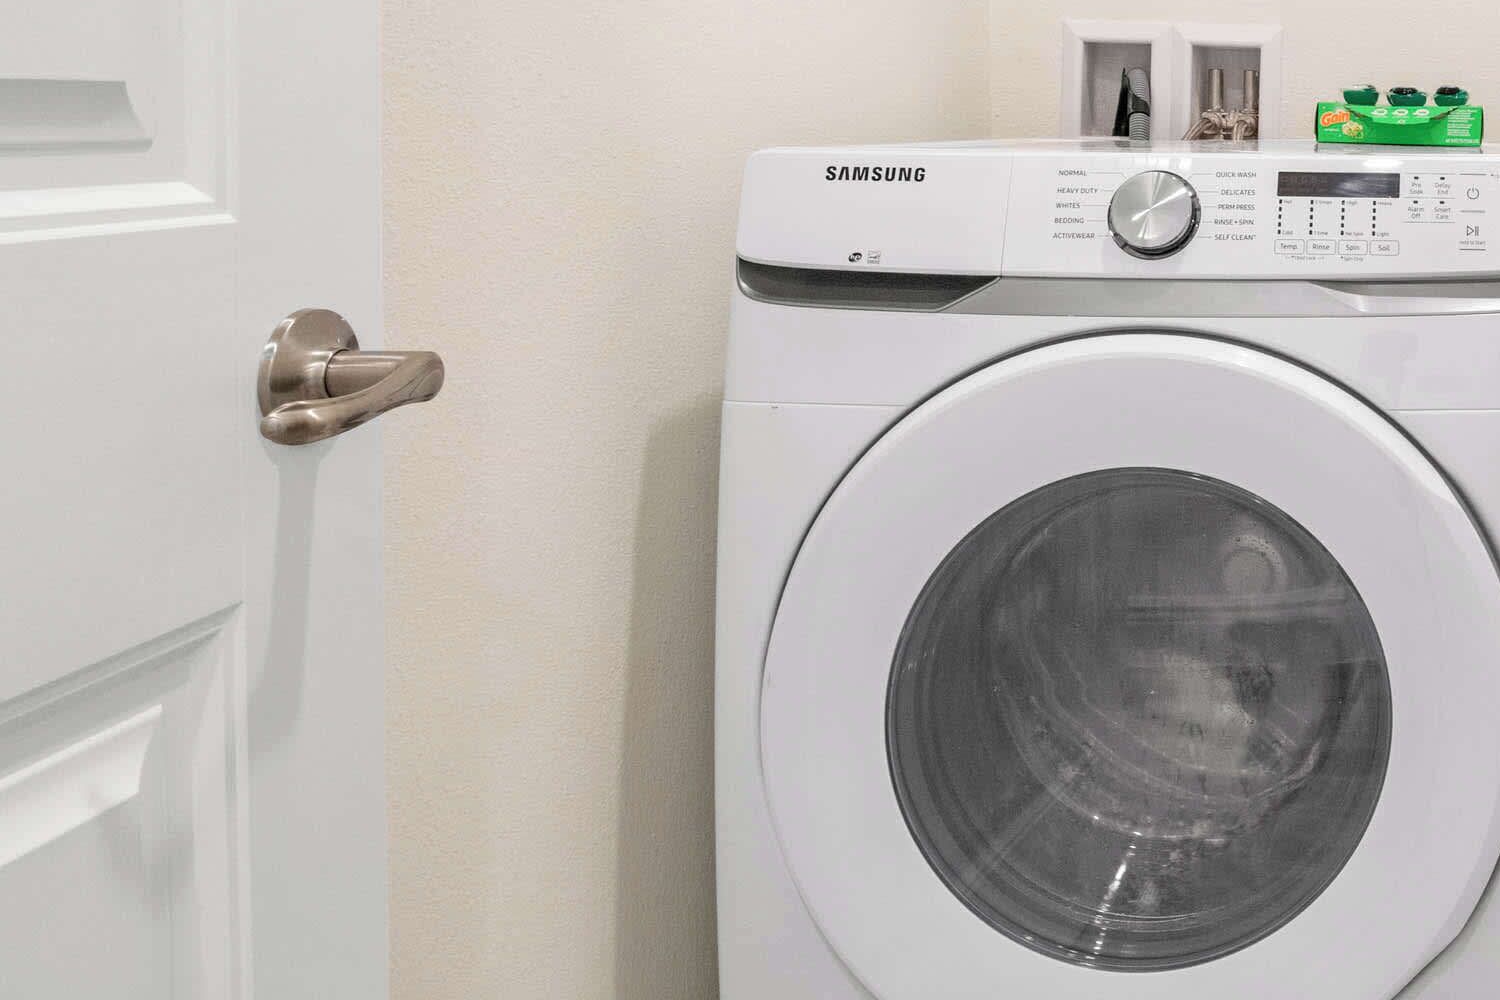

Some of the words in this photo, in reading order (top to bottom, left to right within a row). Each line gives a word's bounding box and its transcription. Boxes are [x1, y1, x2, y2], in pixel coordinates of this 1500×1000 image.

[1320, 111, 1350, 127] Gain
[825, 166, 926, 182] SAMSUNG
[1345, 244, 1361, 252] Spin
[1377, 244, 1391, 252] Soil
